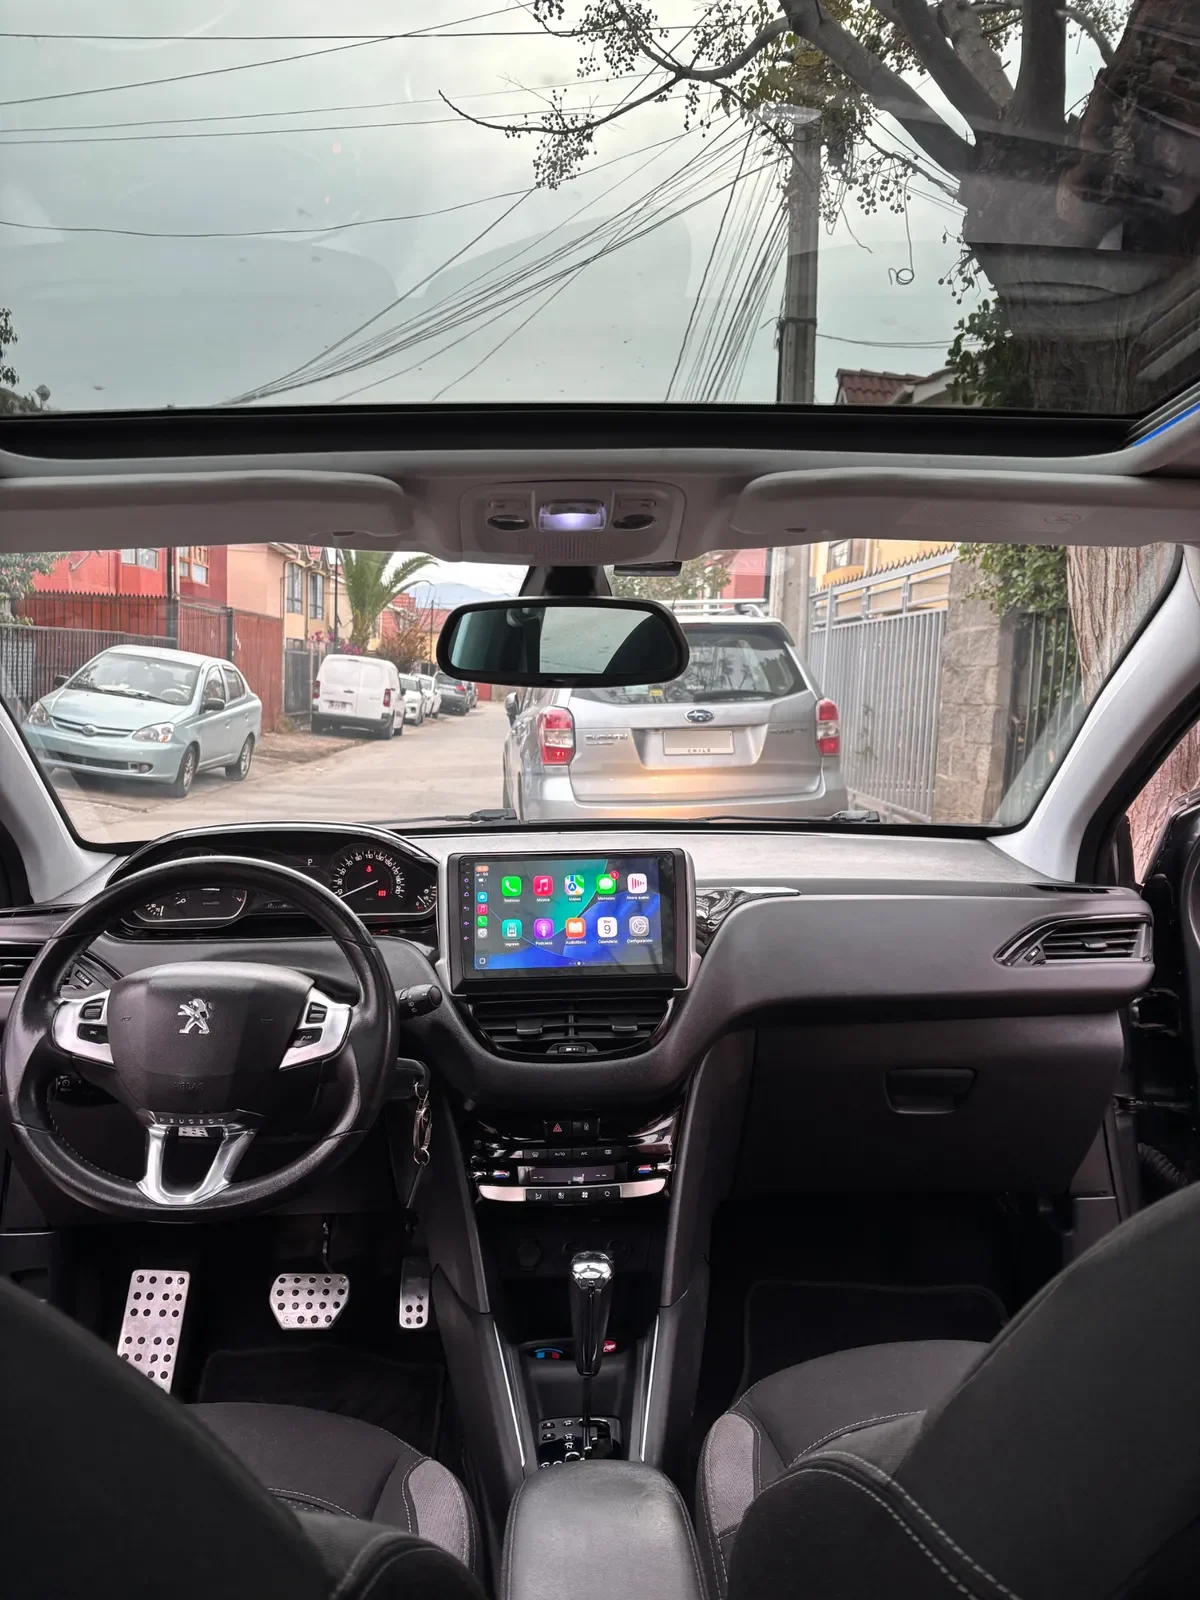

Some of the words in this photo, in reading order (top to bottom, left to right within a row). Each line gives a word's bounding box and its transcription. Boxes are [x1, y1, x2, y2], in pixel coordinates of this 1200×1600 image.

[307, 858, 313, 866] P
[604, 924, 611, 934] 9
[159, 1117, 224, 1125] PEUGEOT
